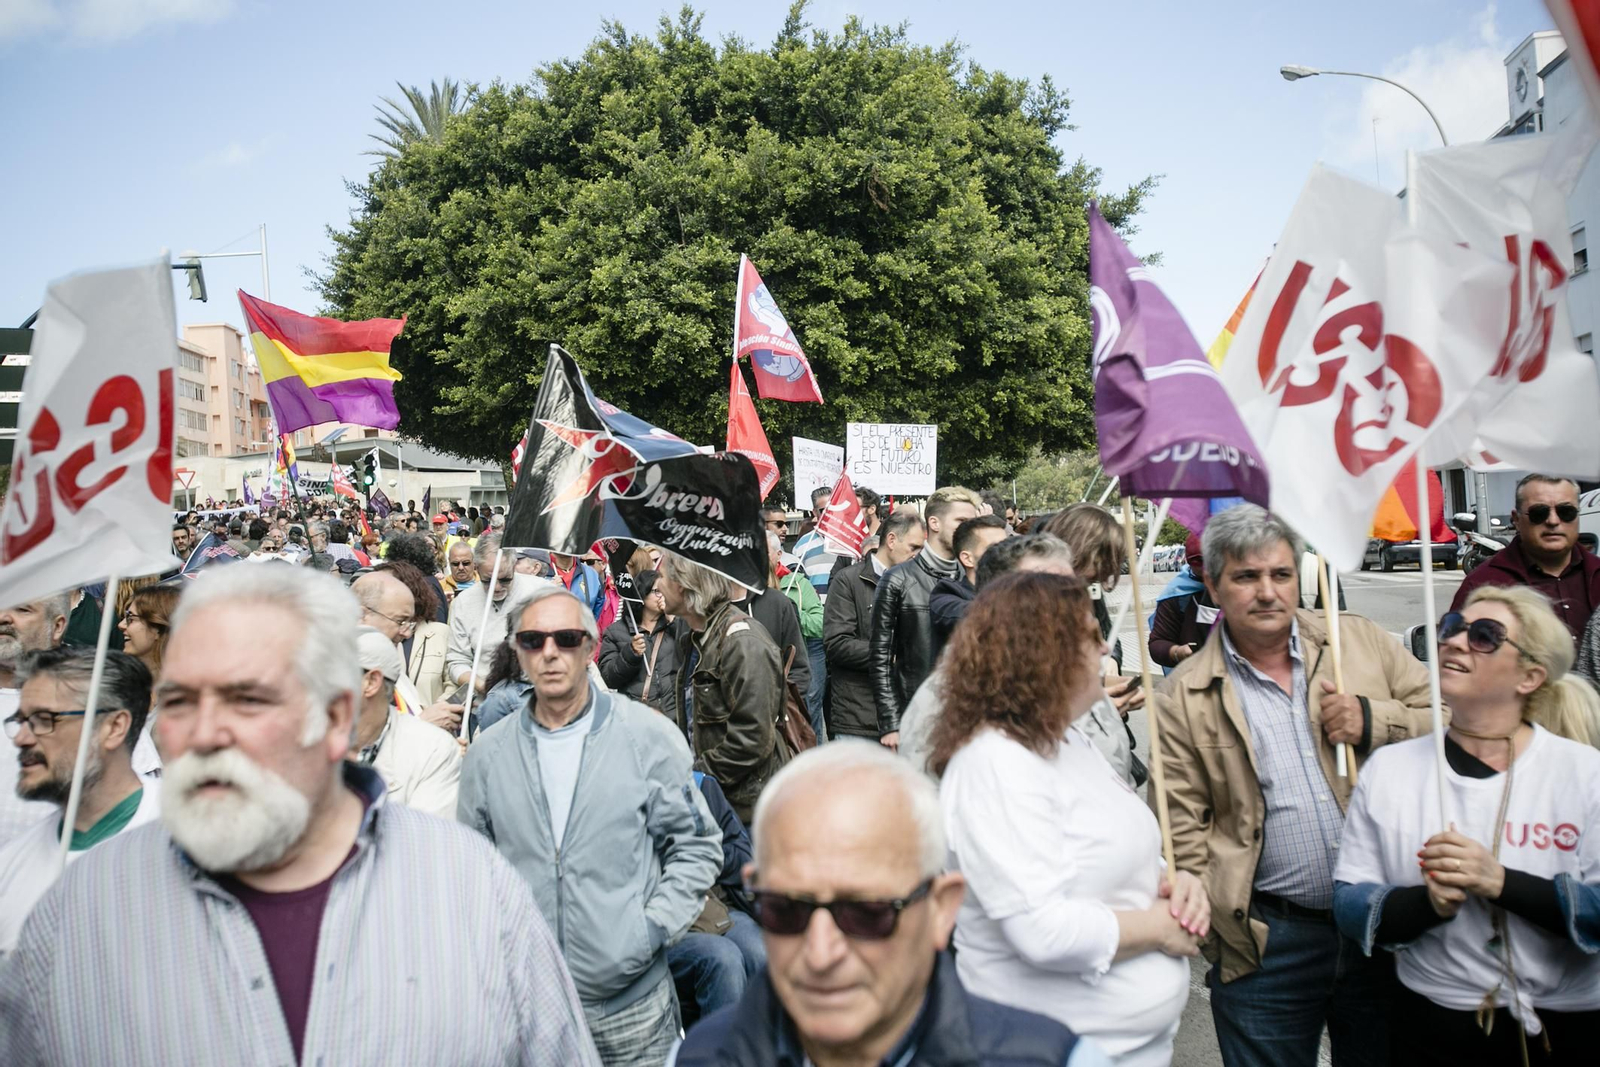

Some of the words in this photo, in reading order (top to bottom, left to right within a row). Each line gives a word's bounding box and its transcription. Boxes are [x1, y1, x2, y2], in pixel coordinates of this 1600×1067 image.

[852, 424, 863, 437] SI
[869, 425, 885, 437] EL
[889, 425, 936, 438] PRESENTE
[862, 436, 876, 449] ES
[879, 436, 890, 450] DE
[862, 449, 877, 462] EL
[881, 449, 921, 464] FUTURO
[855, 462, 872, 475] ES
[881, 463, 932, 475] NUESTRO
[1505, 821, 1581, 852] USO
